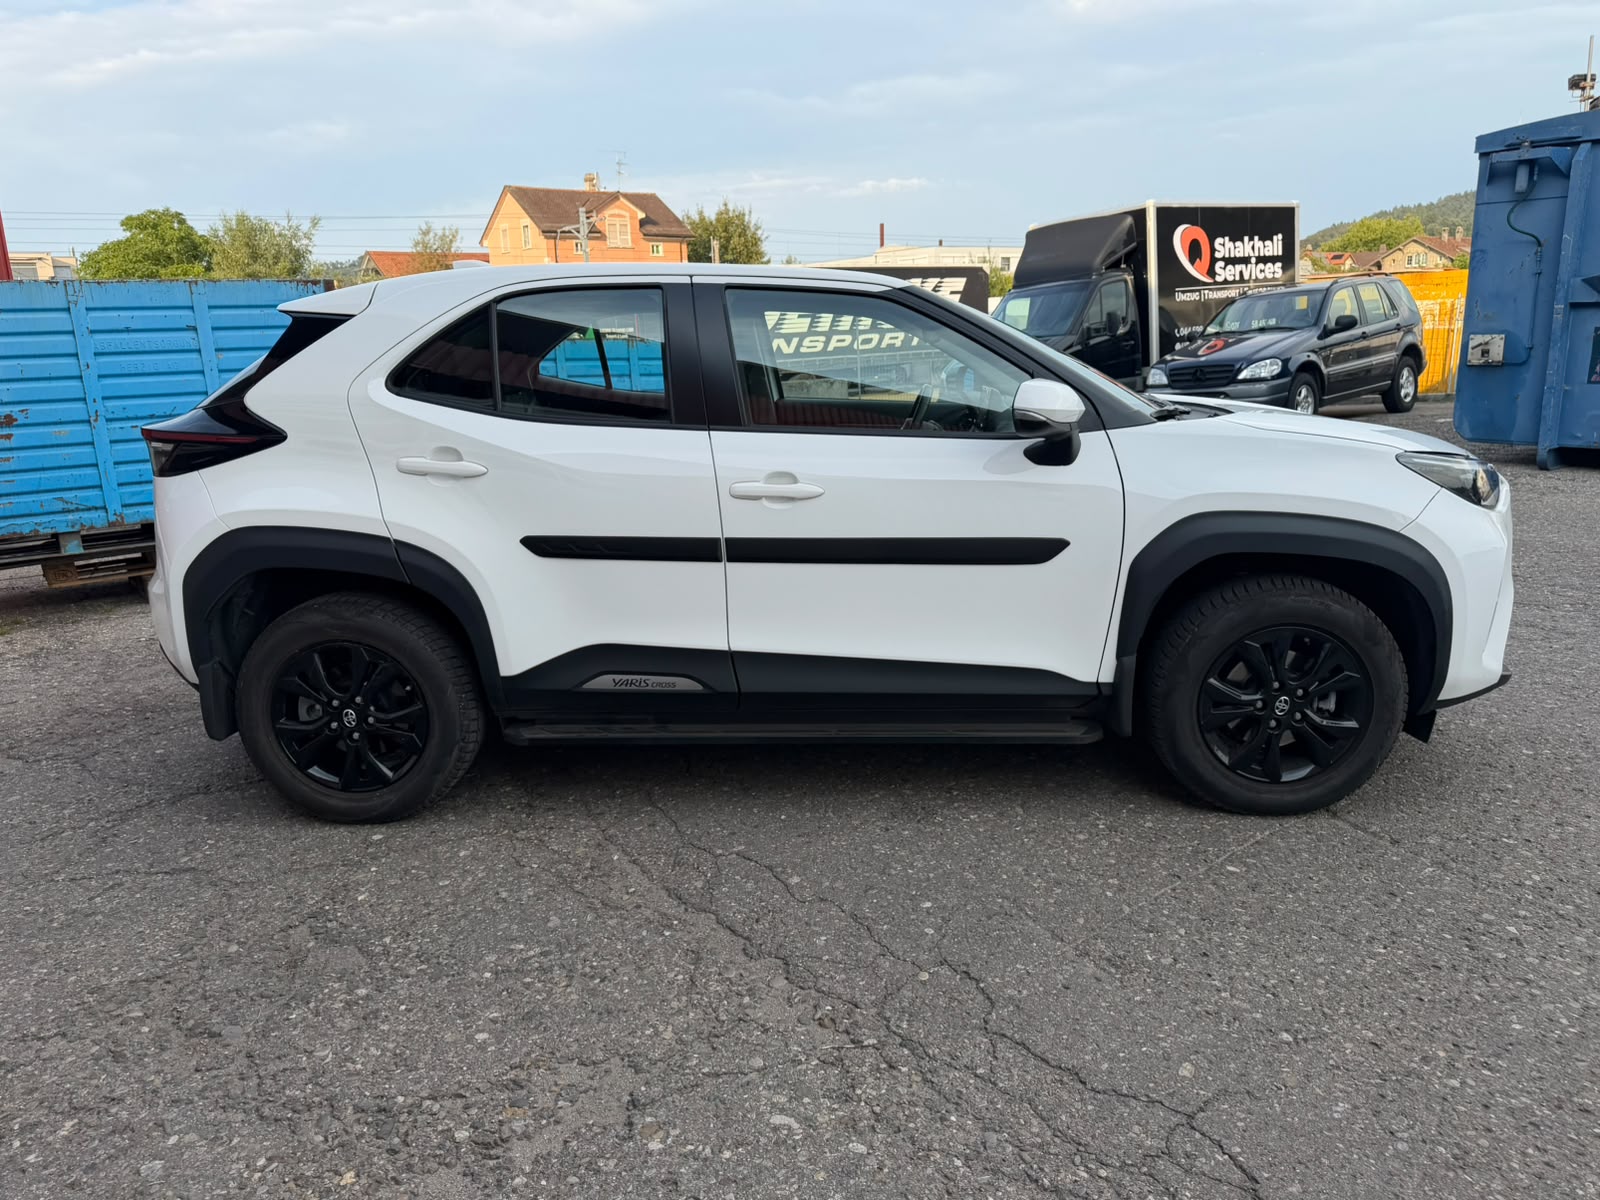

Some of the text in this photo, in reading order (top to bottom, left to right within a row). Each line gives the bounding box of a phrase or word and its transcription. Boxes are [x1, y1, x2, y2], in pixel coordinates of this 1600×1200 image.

[1213, 233, 1283, 258] Shakhali
[1214, 257, 1283, 282] Services
[650, 681, 677, 689] CROSS
